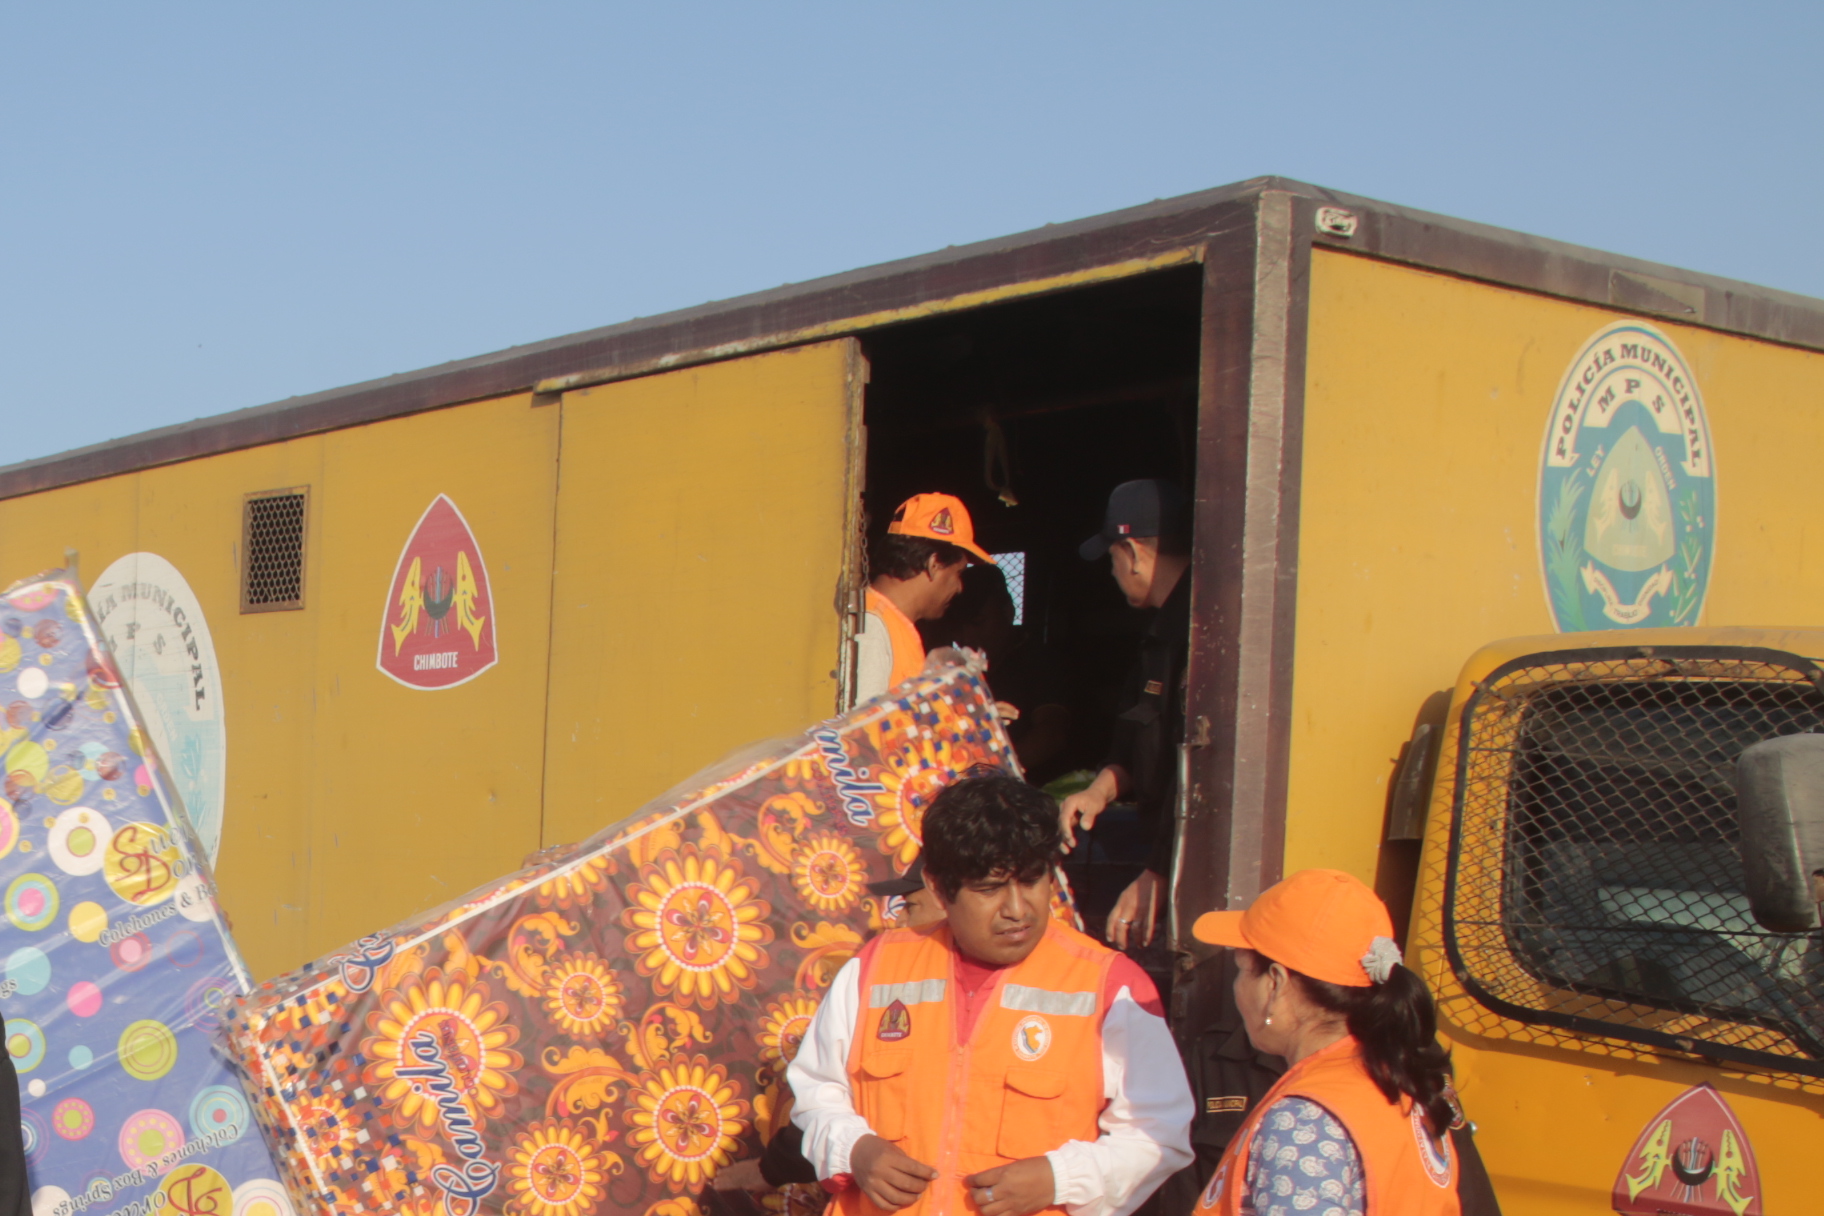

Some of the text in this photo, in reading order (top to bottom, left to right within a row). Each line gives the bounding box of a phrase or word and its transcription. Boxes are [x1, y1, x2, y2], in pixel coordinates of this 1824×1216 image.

[1556, 343, 1702, 468] POLICÍA MUNICIPAL
[1586, 444, 1606, 477] LEY
[1655, 446, 1677, 490] ORDEN
[121, 582, 206, 712] MUNICIPAL
[413, 651, 459, 671] CHIMBOTE
[813, 727, 887, 827] mila
[99, 903, 179, 947] Colchones
[162, 1123, 239, 1167] Colchones
[115, 1169, 145, 1192] Box
[146, 1160, 160, 1179] &
